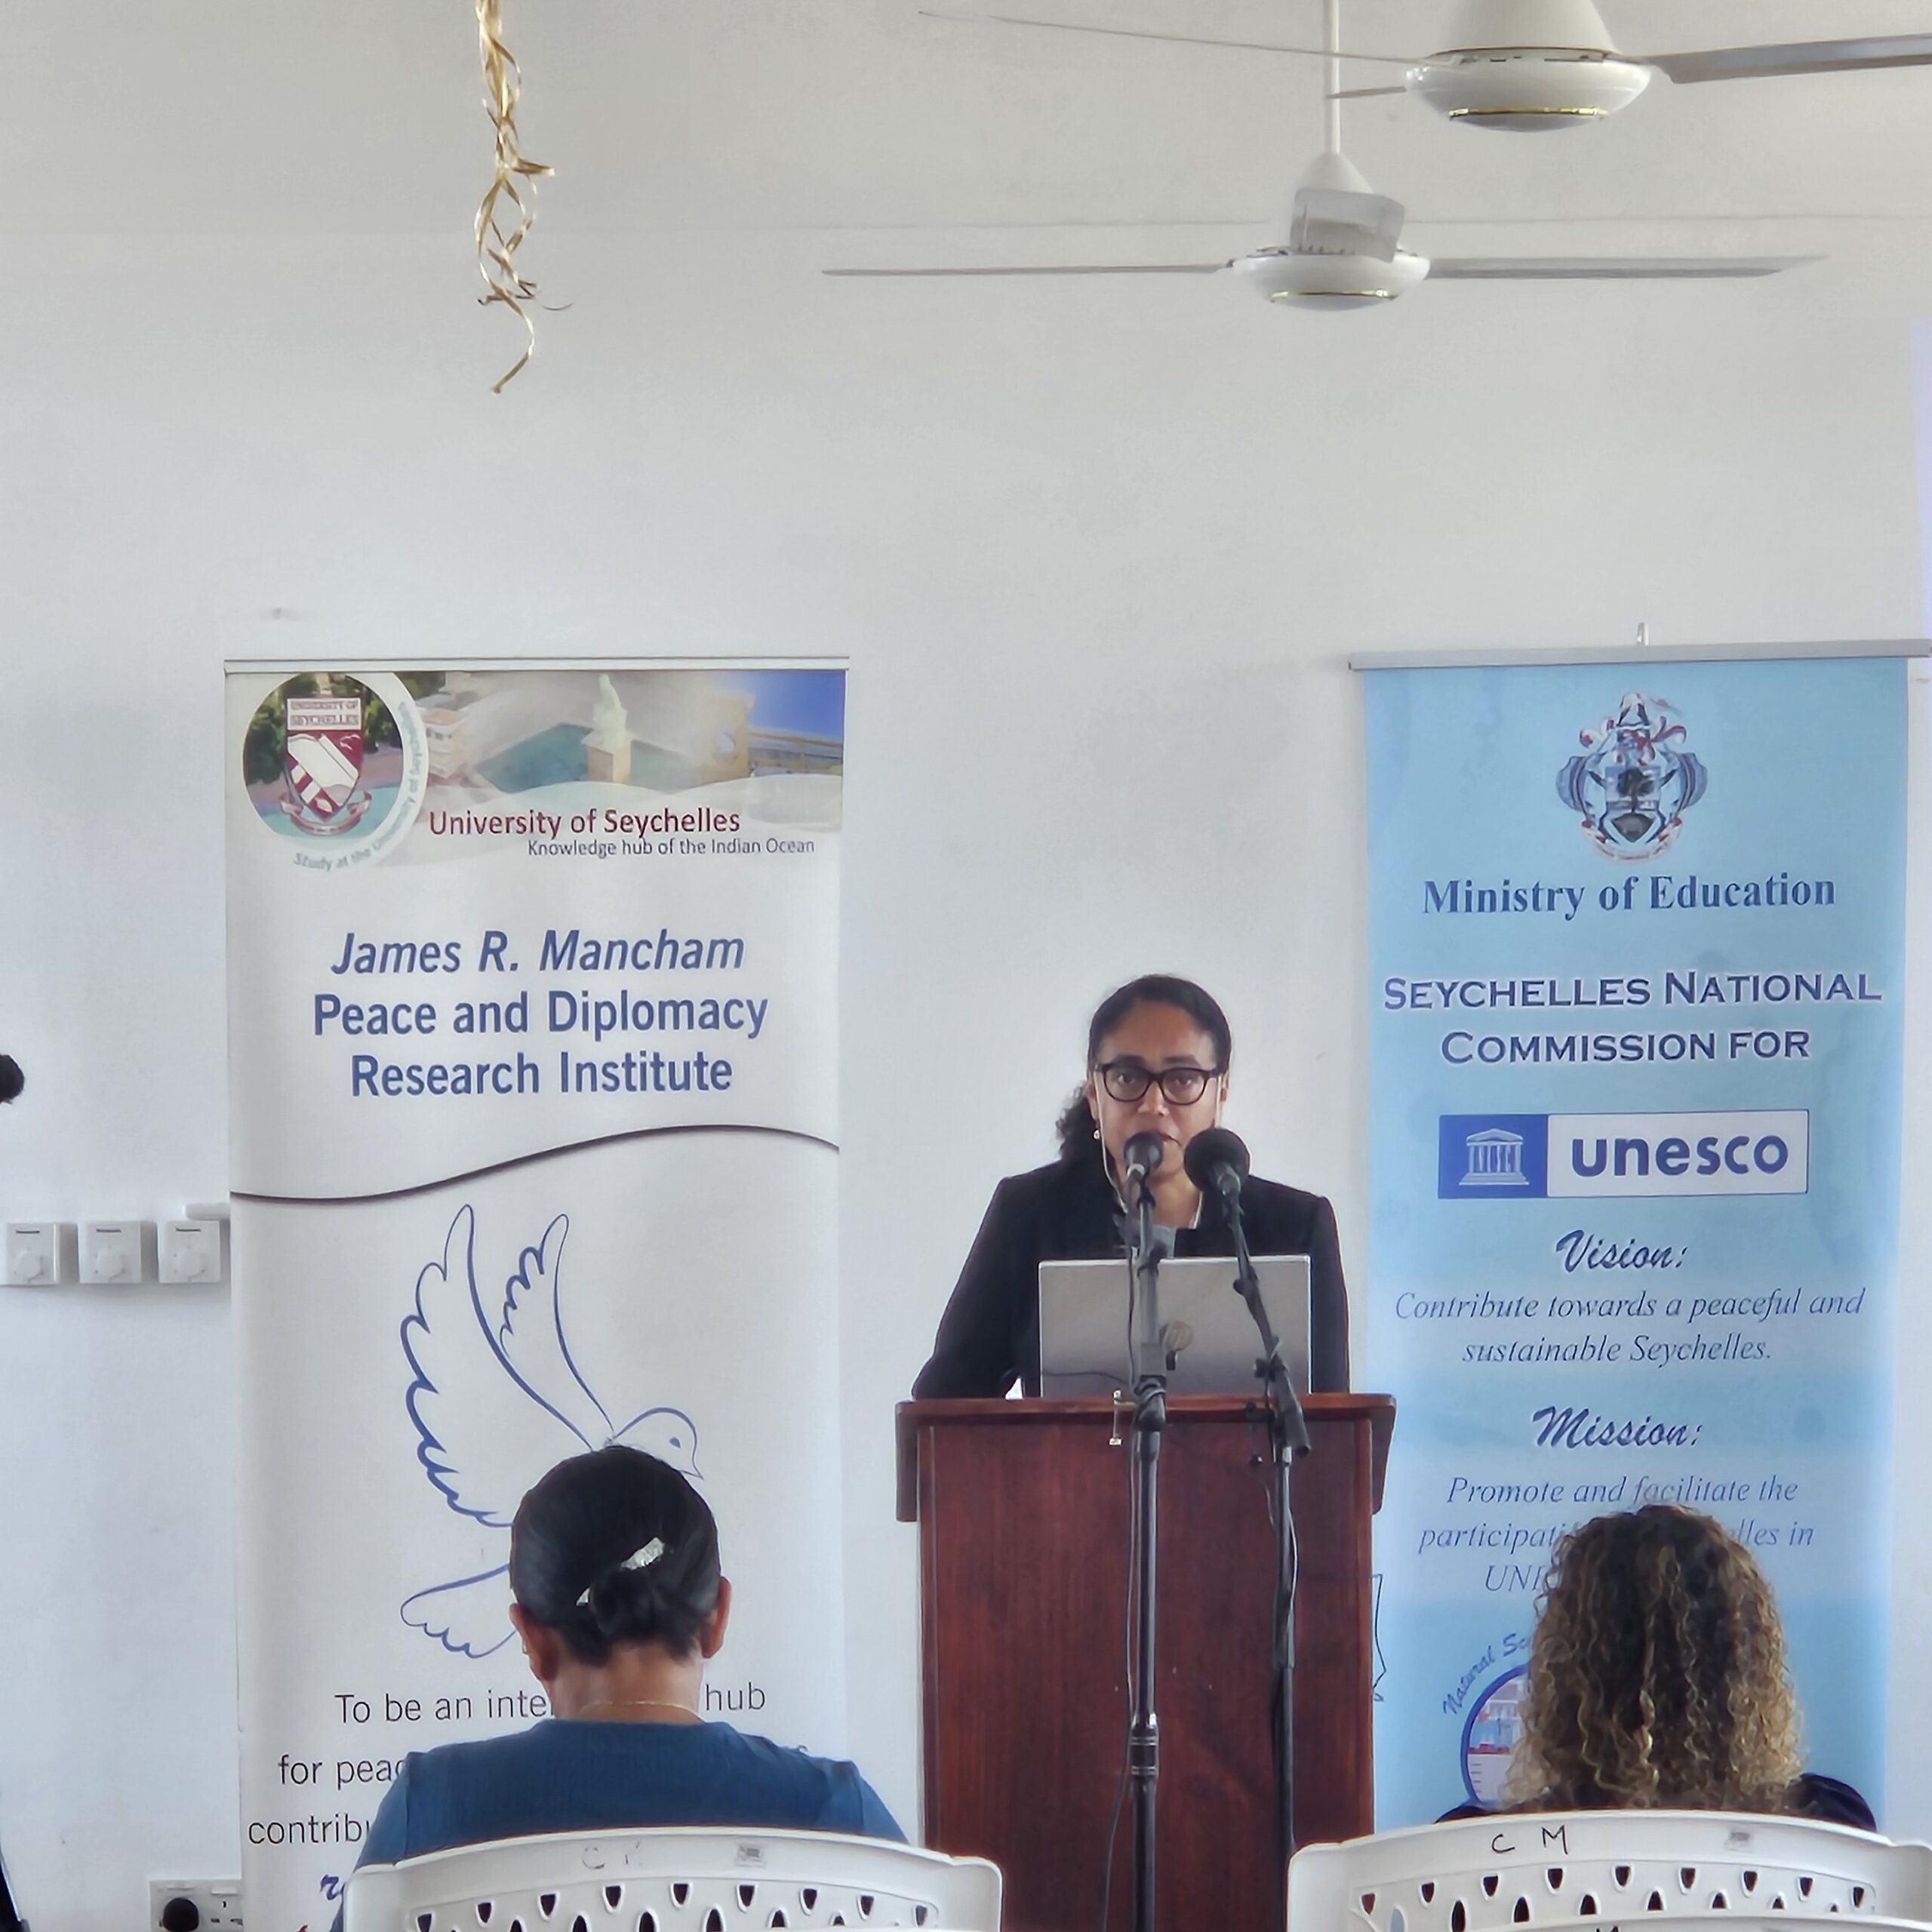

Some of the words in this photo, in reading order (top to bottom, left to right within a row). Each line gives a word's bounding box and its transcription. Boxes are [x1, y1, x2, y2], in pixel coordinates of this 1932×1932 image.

[430, 810, 561, 839] University
[571, 808, 596, 833] of
[605, 808, 740, 838] Seychelles
[292, 852, 332, 872] Study
[528, 839, 617, 859] Knowledge
[622, 838, 652, 854] hub
[658, 838, 675, 854] of
[680, 838, 706, 854] the
[712, 838, 761, 854] Indian
[766, 838, 814, 853] Ocean
[1425, 879, 1585, 921] Ministry
[1599, 876, 1639, 911] of
[1651, 872, 1834, 909] Education
[331, 933, 461, 974] James
[478, 931, 518, 972] R.
[540, 928, 743, 971] Mancham
[315, 994, 436, 1035] Peace
[454, 991, 528, 1033] and
[549, 989, 768, 1041] Diplomacy
[352, 1052, 539, 1097] Research
[561, 1051, 732, 1093] Institute
[1572, 1135, 1788, 1177] unesco
[1556, 1230, 1687, 1272] Vision:
[1396, 1291, 1539, 1318] Contribute
[1549, 1291, 1657, 1317] towards
[1666, 1300, 1681, 1316] a
[1687, 1288, 1801, 1324] peaceful
[1810, 1287, 1866, 1313] and
[1463, 1336, 1621, 1361] sustainable
[1630, 1333, 1770, 1368] Seychelles.
[1533, 1406, 1702, 1448] Mission:
[1447, 1478, 1564, 1503] Promote
[1574, 1476, 1626, 1502] and
[1633, 1475, 1749, 1504] facilitate
[1759, 1475, 1798, 1501] the
[1418, 1523, 1567, 1554] participati
[1789, 1521, 1814, 1546] in
[1442, 1645, 1495, 1715] Natural
[334, 1695, 370, 1723] To
[386, 1694, 420, 1721] be
[435, 1698, 471, 1720] an
[706, 1682, 764, 1711] hub
[278, 1755, 322, 1784] for
[248, 1813, 370, 1844] contrib
